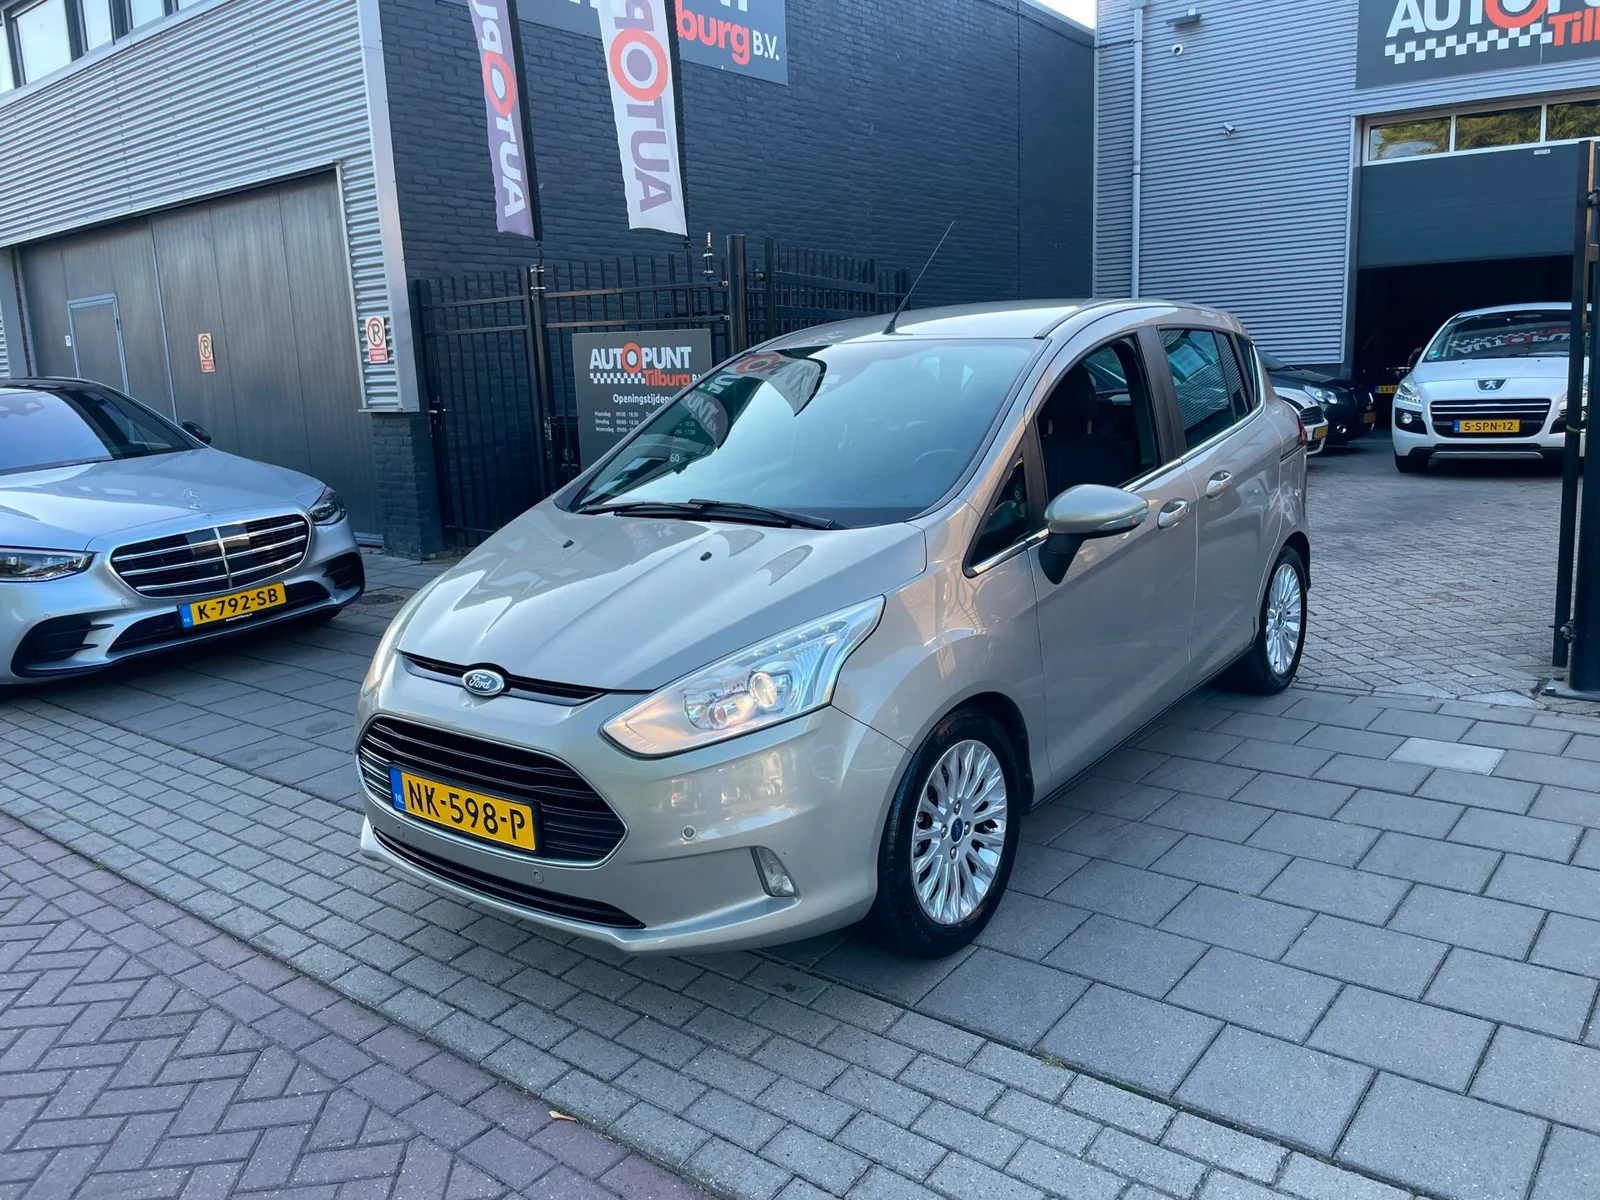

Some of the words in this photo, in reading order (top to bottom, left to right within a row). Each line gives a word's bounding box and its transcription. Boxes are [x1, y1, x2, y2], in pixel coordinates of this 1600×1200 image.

[675, 0, 749, 65] burg
[752, 29, 780, 61] B.V.
[590, 343, 692, 374] AUTOPUNT
[643, 369, 690, 388] Tilburg
[1464, 422, 1513, 431] 5-SPN-12
[198, 588, 278, 620] K-792-SB
[469, 673, 492, 690] Ford
[395, 793, 404, 804] NL
[408, 780, 525, 840] NK-598-P
